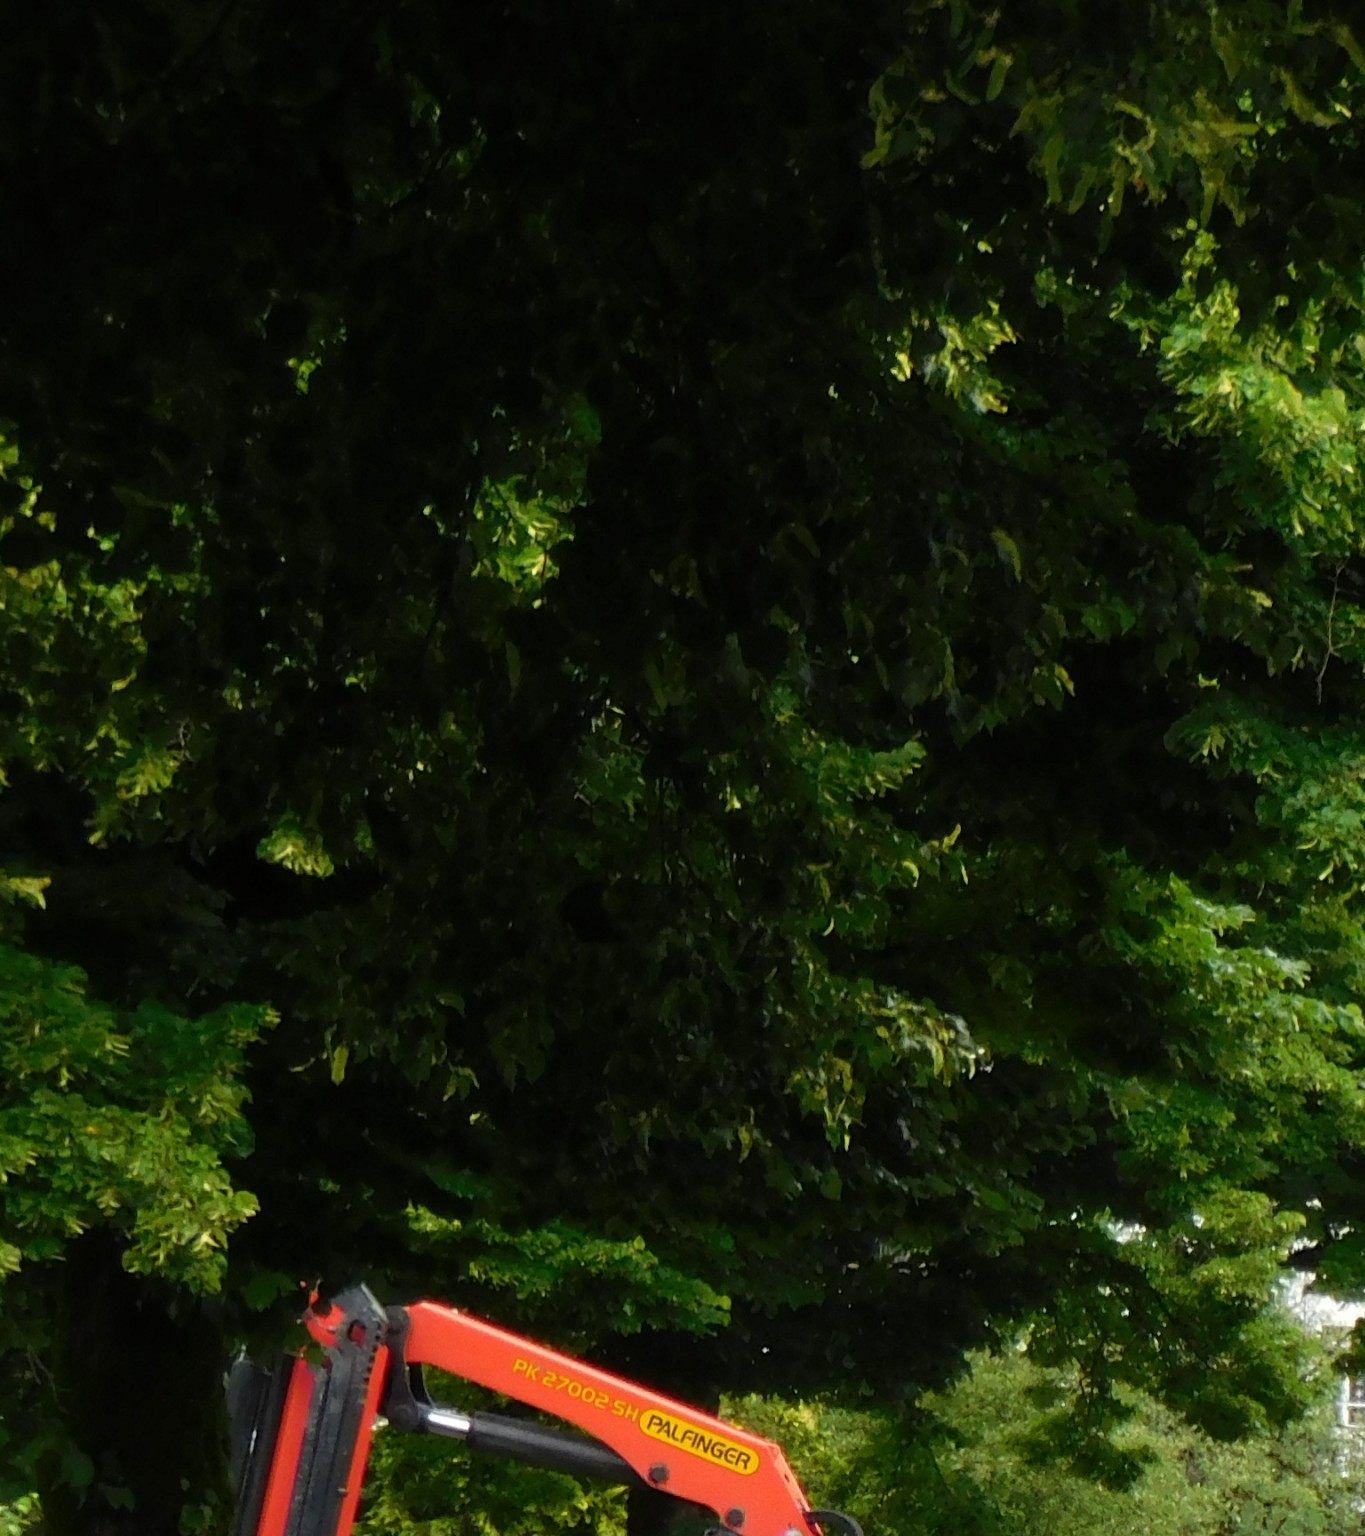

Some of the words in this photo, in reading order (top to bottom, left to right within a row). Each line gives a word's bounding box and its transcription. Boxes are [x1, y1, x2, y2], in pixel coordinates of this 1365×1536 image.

[512, 1358, 541, 1381] PK
[542, 1370, 610, 1410] 27002
[611, 1399, 640, 1423] SH
[647, 1413, 752, 1471] PALFINGER
